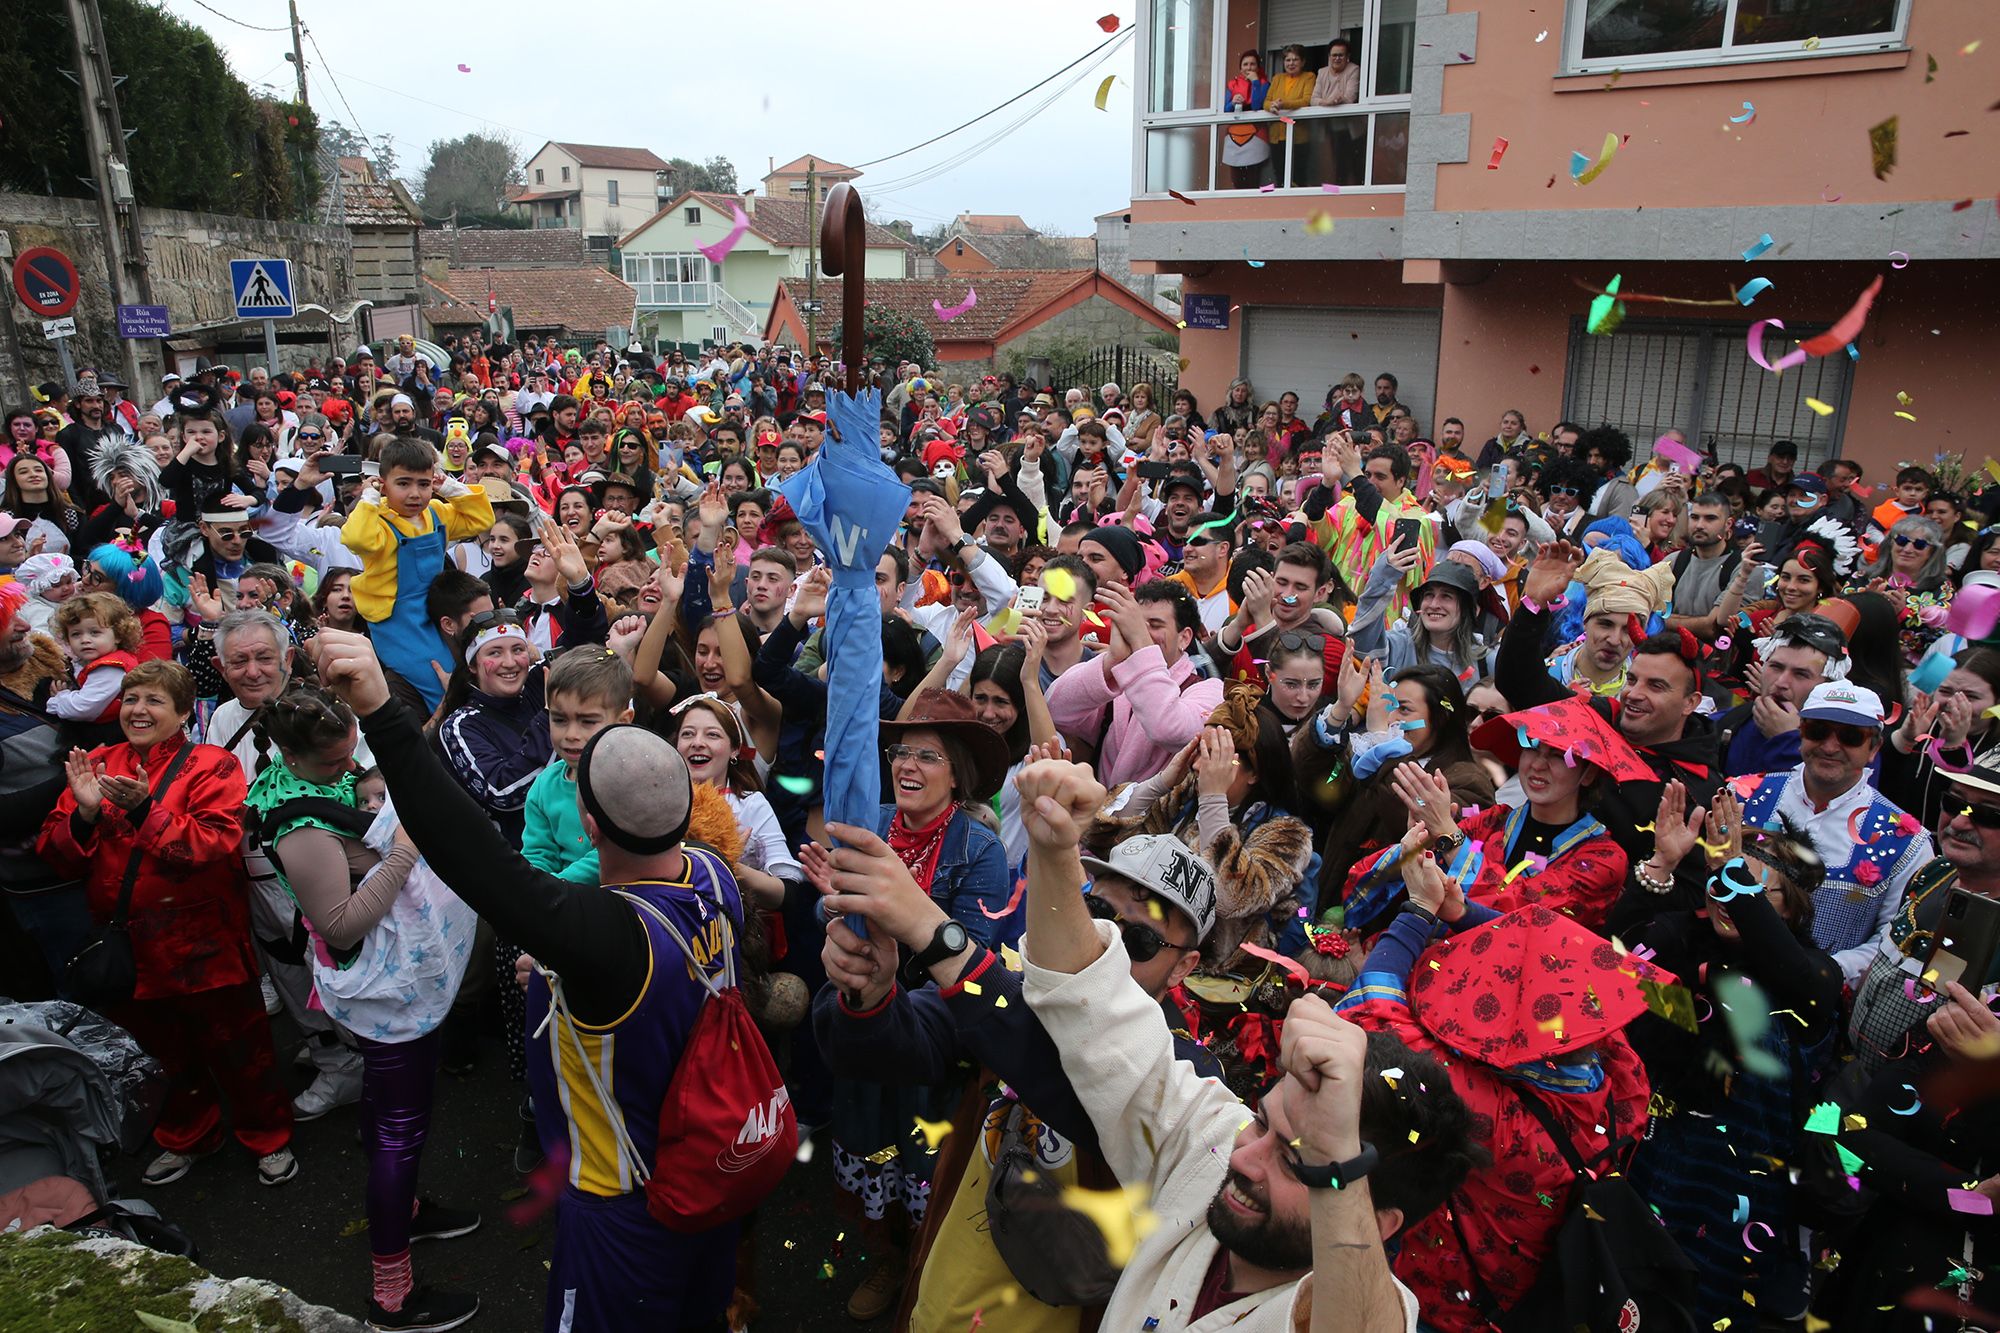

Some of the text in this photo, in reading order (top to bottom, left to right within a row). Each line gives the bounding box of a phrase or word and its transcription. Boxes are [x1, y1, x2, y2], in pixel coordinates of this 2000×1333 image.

[135, 308, 150, 316] Rúa
[1195, 306, 1219, 315] Baixada
[1199, 315, 1221, 325] Nerga
[127, 325, 163, 334] de Nerga
